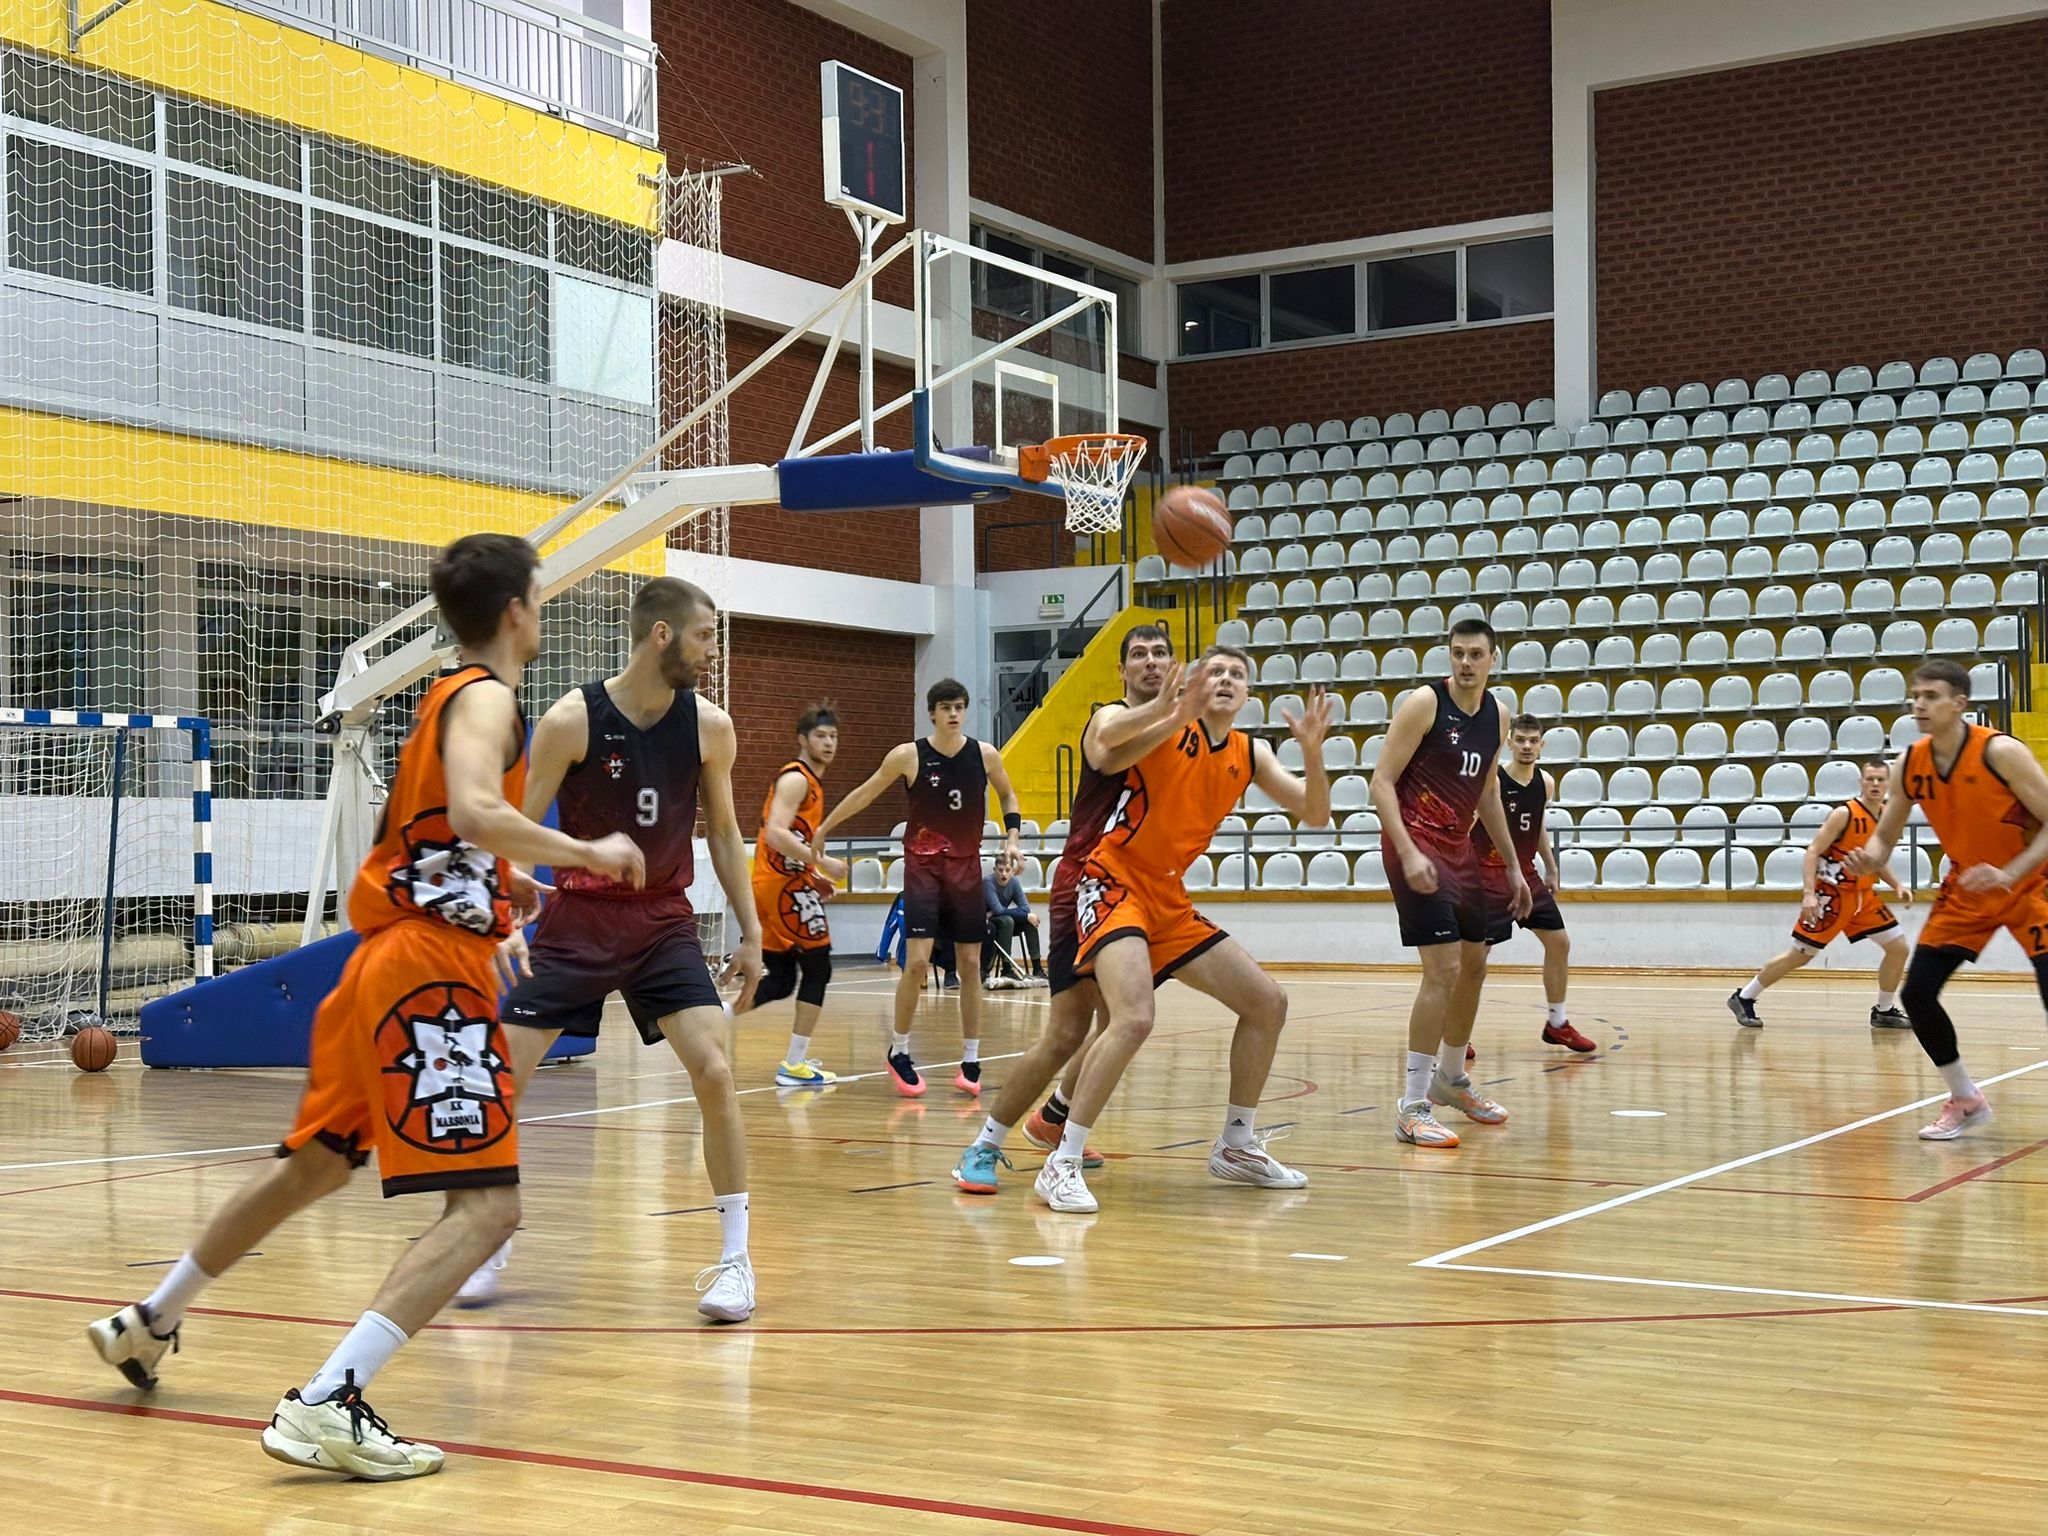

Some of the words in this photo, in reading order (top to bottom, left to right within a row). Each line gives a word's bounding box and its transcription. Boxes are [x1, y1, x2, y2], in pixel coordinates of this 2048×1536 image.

[1177, 725, 1200, 758] 19
[1459, 750, 1482, 777] 10
[1912, 774, 1936, 800] 21
[635, 787, 659, 827] 9
[948, 789, 962, 810] 3
[1519, 813, 1532, 831] 5
[1853, 817, 1868, 834] 11
[450, 1100, 464, 1111] KK
[435, 1114, 480, 1128] MARSONIA
